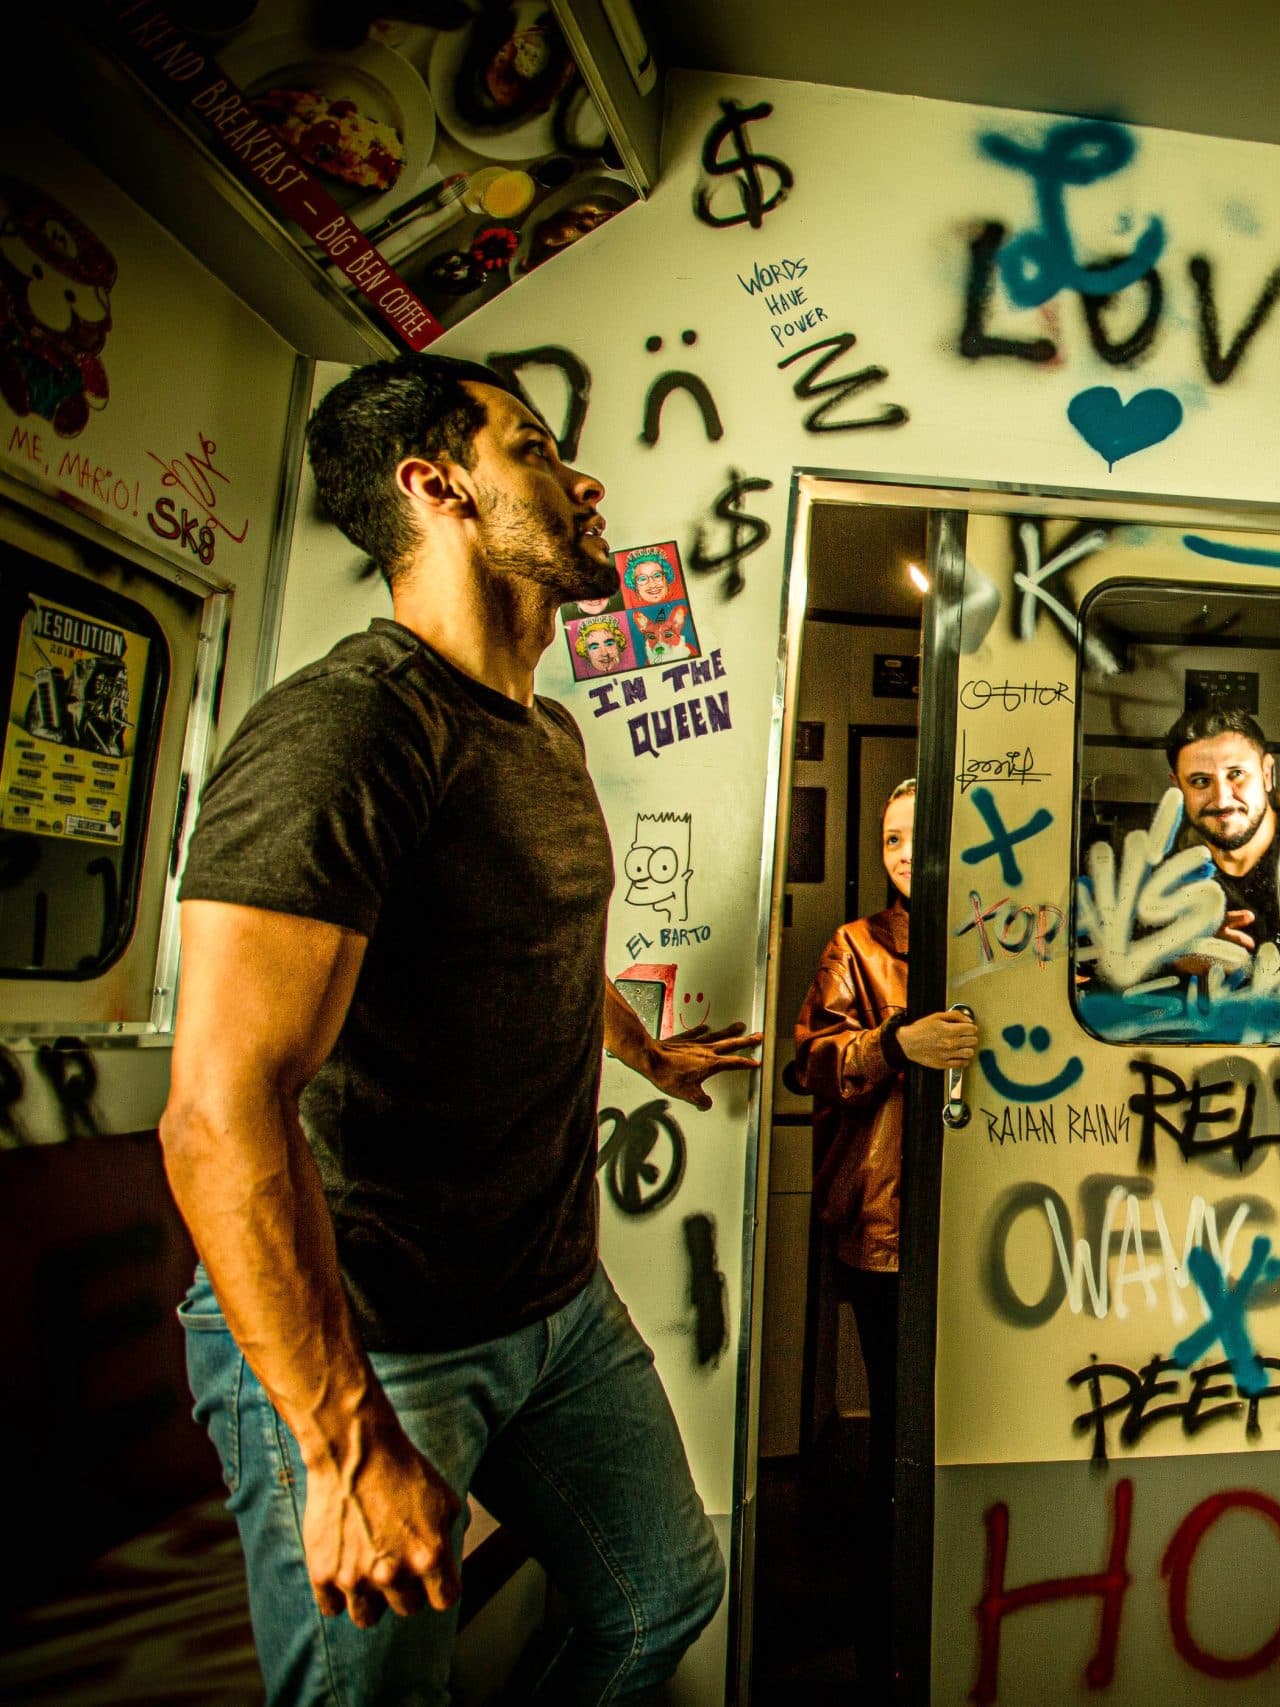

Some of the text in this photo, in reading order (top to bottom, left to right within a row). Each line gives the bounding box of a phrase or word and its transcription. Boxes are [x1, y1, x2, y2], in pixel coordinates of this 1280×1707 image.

[192, 80, 309, 193] BREAKFAST
[315, 216, 352, 255] BIG
[345, 249, 391, 294] BEN
[379, 286, 433, 341] COFFEE
[736, 257, 809, 297] WORDS
[764, 286, 809, 316] HAVE
[770, 306, 829, 348] POWER
[588, 647, 727, 718] I'M THE
[627, 690, 733, 759] QUEEN
[624, 925, 712, 961] EL BARTO
